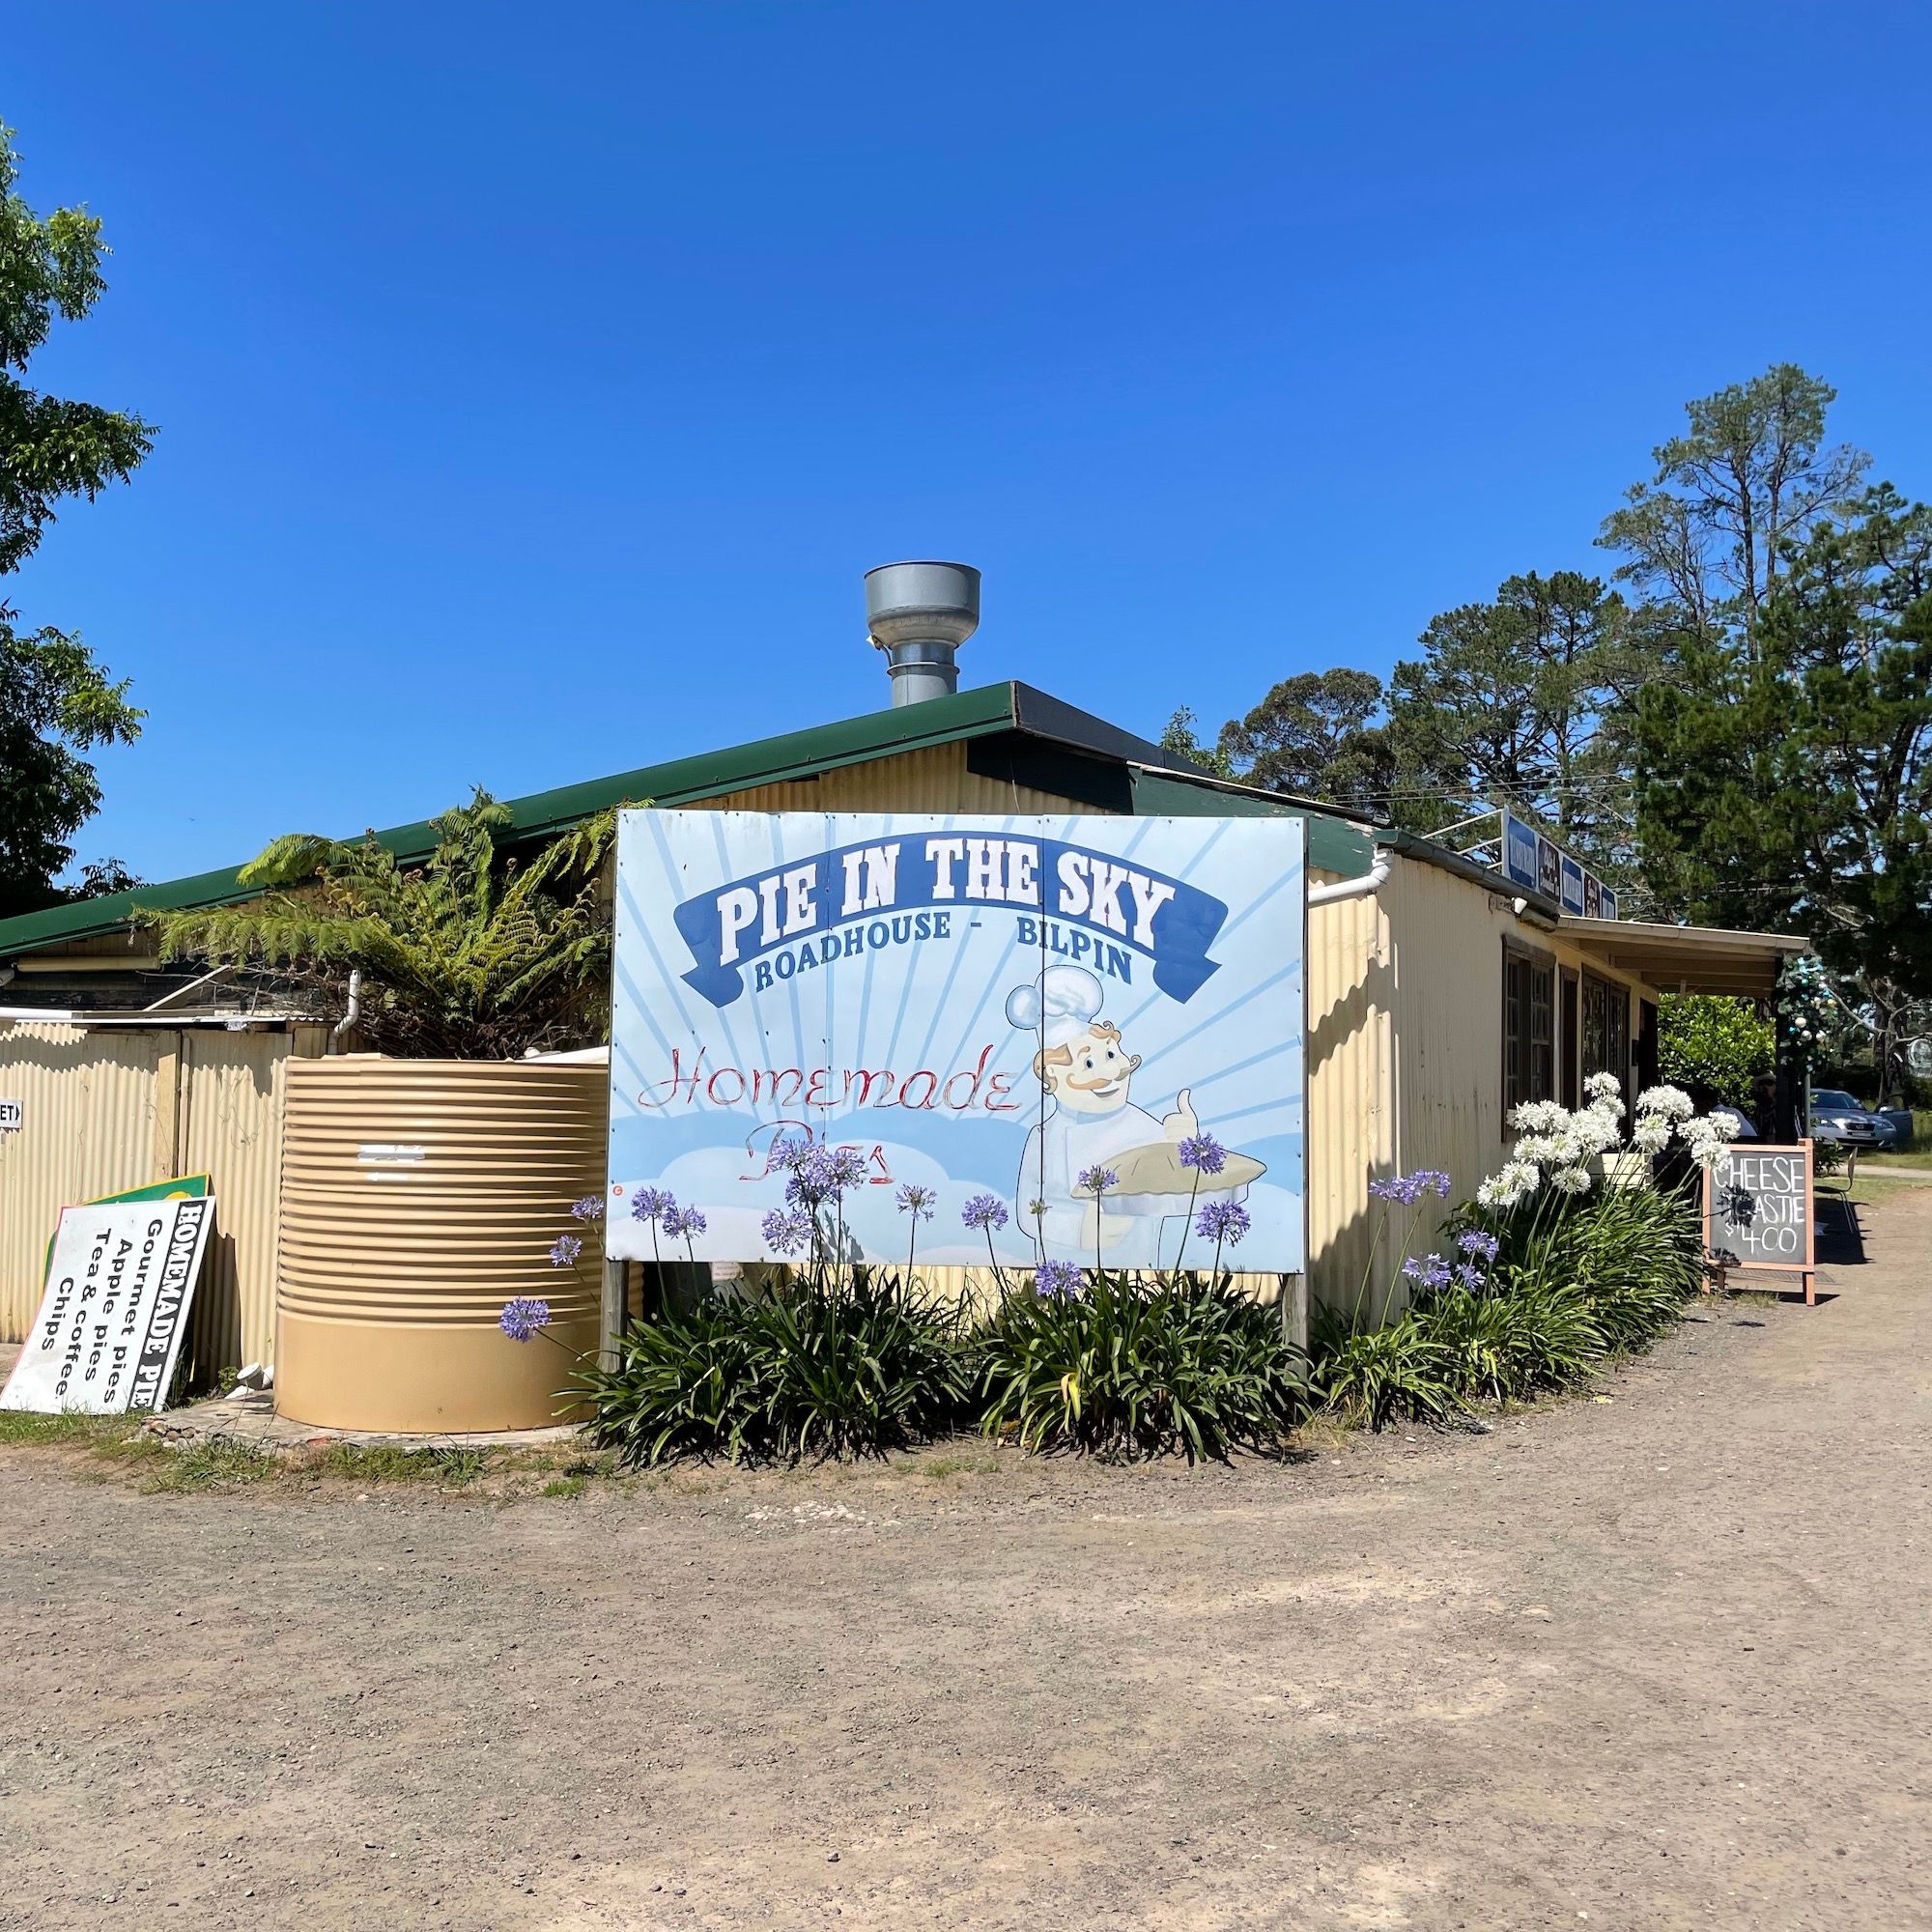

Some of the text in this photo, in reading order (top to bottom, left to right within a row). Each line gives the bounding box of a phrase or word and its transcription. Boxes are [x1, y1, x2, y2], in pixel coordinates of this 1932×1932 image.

[717, 838, 1176, 967] PIE IN THE SKY
[755, 911, 951, 993] ROADHOUSE
[1016, 916, 1131, 985] BILPIN
[638, 1043, 1022, 1110] Homemade
[1713, 1156, 1804, 1193] CHEESE
[1727, 1193, 1804, 1224] ASTIE
[42, 1277, 74, 1351] Chips
[55, 1228, 112, 1397] Tea & coffee
[85, 1238, 133, 1381] Apple pies
[103, 1219, 162, 1404] Gourmet pies
[143, 1203, 203, 1355] HOMEMADE
